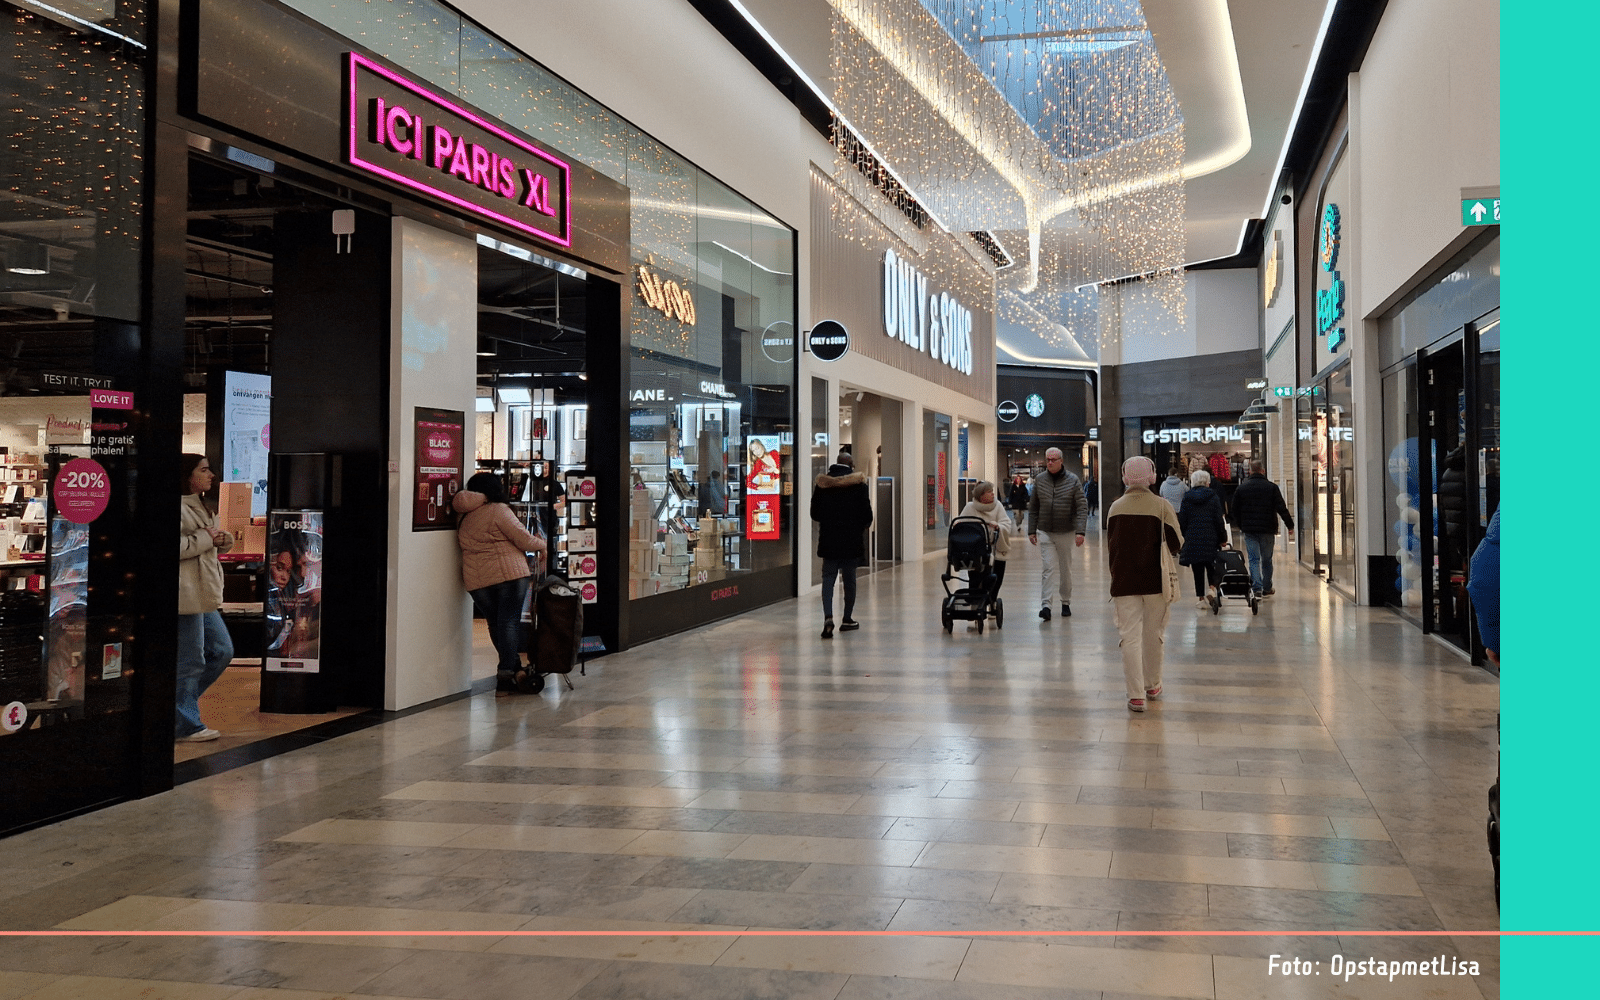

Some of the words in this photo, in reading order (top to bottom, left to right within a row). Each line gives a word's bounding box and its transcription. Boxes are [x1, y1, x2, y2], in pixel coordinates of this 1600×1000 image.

[375, 97, 423, 160] ICI
[430, 125, 516, 199] PARIS
[523, 168, 557, 218] XL
[884, 248, 927, 352] ONLY
[929, 294, 938, 360] &
[940, 291, 972, 376] SONS
[810, 337, 826, 346] ONLY
[831, 336, 847, 345] SONS
[43, 374, 67, 385] TEST
[83, 378, 101, 388] TRY
[104, 380, 112, 388] IT
[700, 381, 725, 394] CHANEL
[94, 394, 119, 404] LOVE
[121, 396, 130, 404] IT
[97, 436, 106, 444] je
[1143, 427, 1201, 444] G-STAR
[1205, 426, 1244, 441] RAW
[429, 439, 451, 448] BLACK
